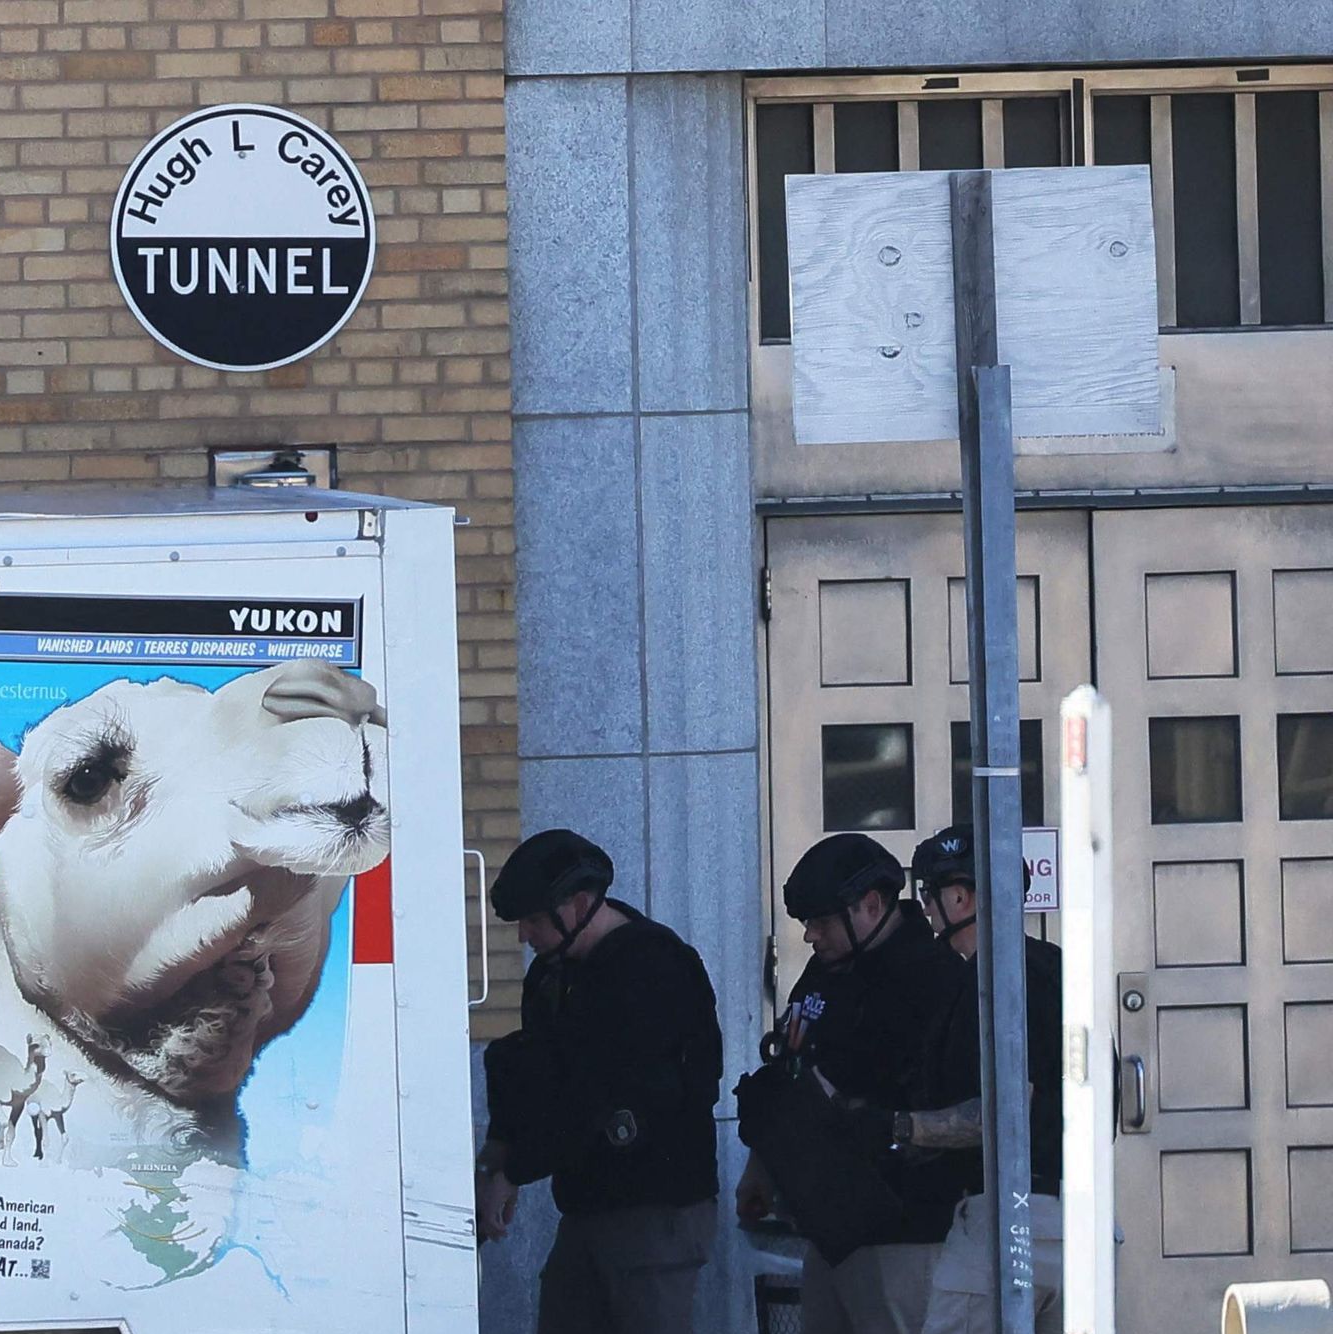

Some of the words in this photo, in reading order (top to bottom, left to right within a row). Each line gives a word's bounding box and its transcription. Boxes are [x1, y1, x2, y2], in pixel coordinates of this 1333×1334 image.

[127, 137, 212, 224] Hugh
[232, 121, 255, 152] L
[278, 131, 361, 227] Carey
[137, 248, 349, 294] TUNNEL
[229, 607, 342, 633] YUKON
[37, 638, 94, 654] VANISHED
[96, 639, 133, 655] LANDS
[144, 641, 188, 656] TERRES
[191, 642, 256, 657] DISPARUES
[267, 643, 343, 658] WHITEHORSE
[131, 1164, 179, 1173] BERINGIA
[12, 1216, 43, 1232] land.
